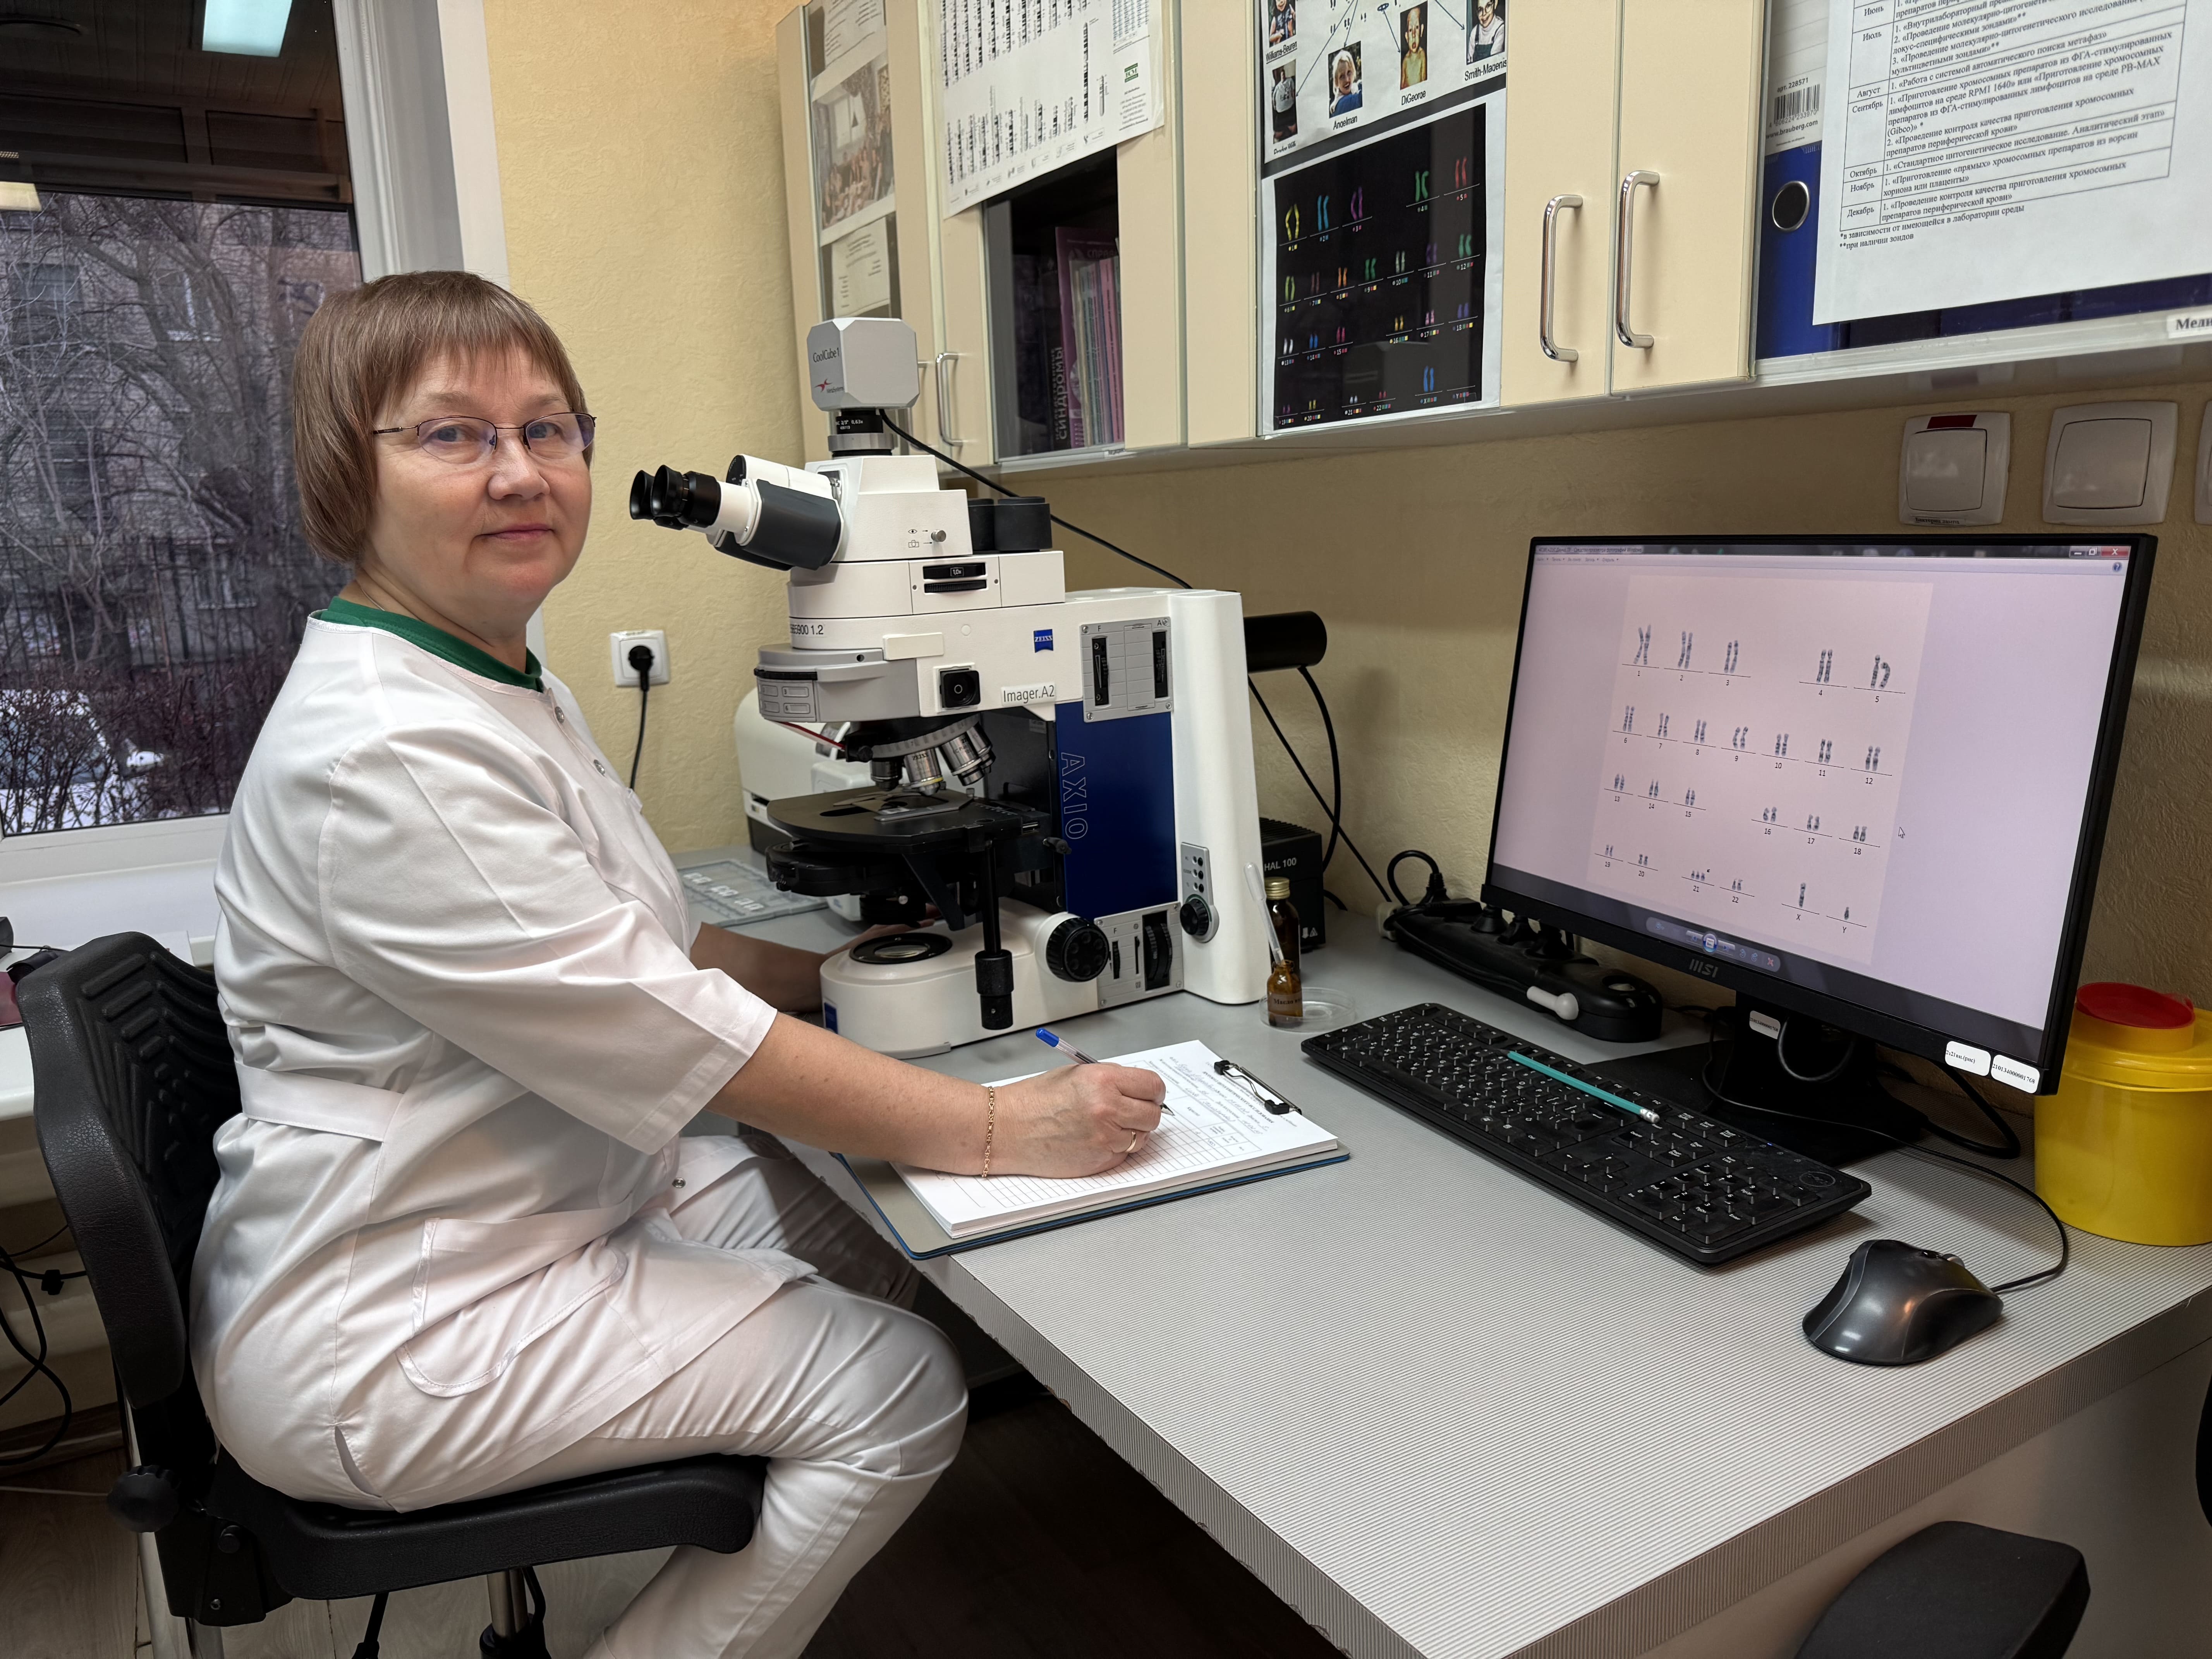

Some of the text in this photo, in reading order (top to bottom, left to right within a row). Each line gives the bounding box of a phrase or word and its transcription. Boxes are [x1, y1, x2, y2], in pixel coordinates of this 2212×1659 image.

[1864, 6, 1884, 17] Июнь
[1863, 31, 1882, 41] Июль
[1893, 57, 1898, 65] 3.
[1901, 46, 1948, 62] «Проведение
[1950, 12, 2077, 50] молекулярно-цитогенетического
[1893, 27, 1980, 55] локус-специфическими
[1894, 24, 1950, 44] 2. «Проведение
[1891, 55, 1953, 76] мультицветными
[1898, 84, 1958, 102] «Приготовление
[1960, 71, 2011, 89] хромосомных
[2013, 60, 2058, 77] препаратов
[2071, 32, 2172, 62] ФГА-стимулированных
[1899, 76, 1927, 88] «Работа
[1935, 64, 1970, 79] системой
[1972, 50, 2035, 70] автоматического
[2037, 42, 2065, 54] поиска
[2068, 32, 2107, 46] метафаз»
[1789, 77, 1808, 89] 228571
[1888, 100, 1933, 115] лимфоцитов
[1946, 93, 1966, 103] среде
[1994, 80, 2015, 91] 1640»
[2018, 77, 2032, 86] или
[2034, 61, 2102, 81] «Приготовление
[2104, 46, 2164, 67] хромосомных
[1857, 87, 1881, 98] Август
[1888, 112, 1928, 127] препаратов
[1940, 89, 2028, 114] ФГА-стимулированных
[2030, 77, 2081, 94] лимфоцитов
[2095, 68, 2119, 81] среде
[1796, 109, 1817, 120] 233970
[1852, 101, 1883, 113] Сентябрь
[1895, 130, 1942, 144] «Проведение
[1944, 122, 1978, 134] контроля
[1980, 115, 2012, 127] качества
[2014, 101, 2073, 120] приготовления
[2075, 88, 2134, 108] хромосомных
[1887, 124, 1917, 137] (Gibco)»
[1893, 155, 1944, 169] «Стандартное
[1946, 141, 2012, 160] цитогенетическое
[2014, 130, 2069, 146] исследование.
[2072, 114, 2138, 134] Аналитический
[2141, 110, 2165, 120] этап»
[1886, 125, 2018, 158] препаратов периферической крови»
[1893, 168, 1951, 184] «Приготовление
[1953, 161, 1990, 173] «прямых»
[1992, 150, 2046, 167] хромосомных
[2048, 141, 2094, 156] препаратов
[2109, 132, 2138, 144] ворсин
[1850, 168, 1877, 178] Октябрь
[1850, 182, 1875, 192] Ноябрь
[1883, 186, 1912, 197] хориона
[1929, 176, 1969, 188] плаценты»
[1891, 196, 1937, 210] «Проведение
[1939, 190, 1973, 201] контроля
[1975, 184, 2007, 195] качества
[2009, 173, 2067, 190] приготовления
[2069, 162, 2126, 180] хромосомных
[1847, 206, 1874, 218] Декабрь
[1882, 194, 2012, 222] препаратов периферической крови»
[1849, 227, 1891, 239] зависимости
[1902, 218, 1945, 230] имеющейся
[1953, 209, 2000, 222] лаборатории
[2001, 205, 2025, 216] среды
[1860, 237, 1888, 247] наличии
[1889, 234, 1914, 242] зондов
[811, 625, 824, 635] 1.2
[1003, 685, 1055, 703] Imager.A2
[1061, 752, 1088, 840] AXIO
[1264, 857, 1297, 871] HAL 100
[1992, 1063, 2035, 1084] 210134000001768
